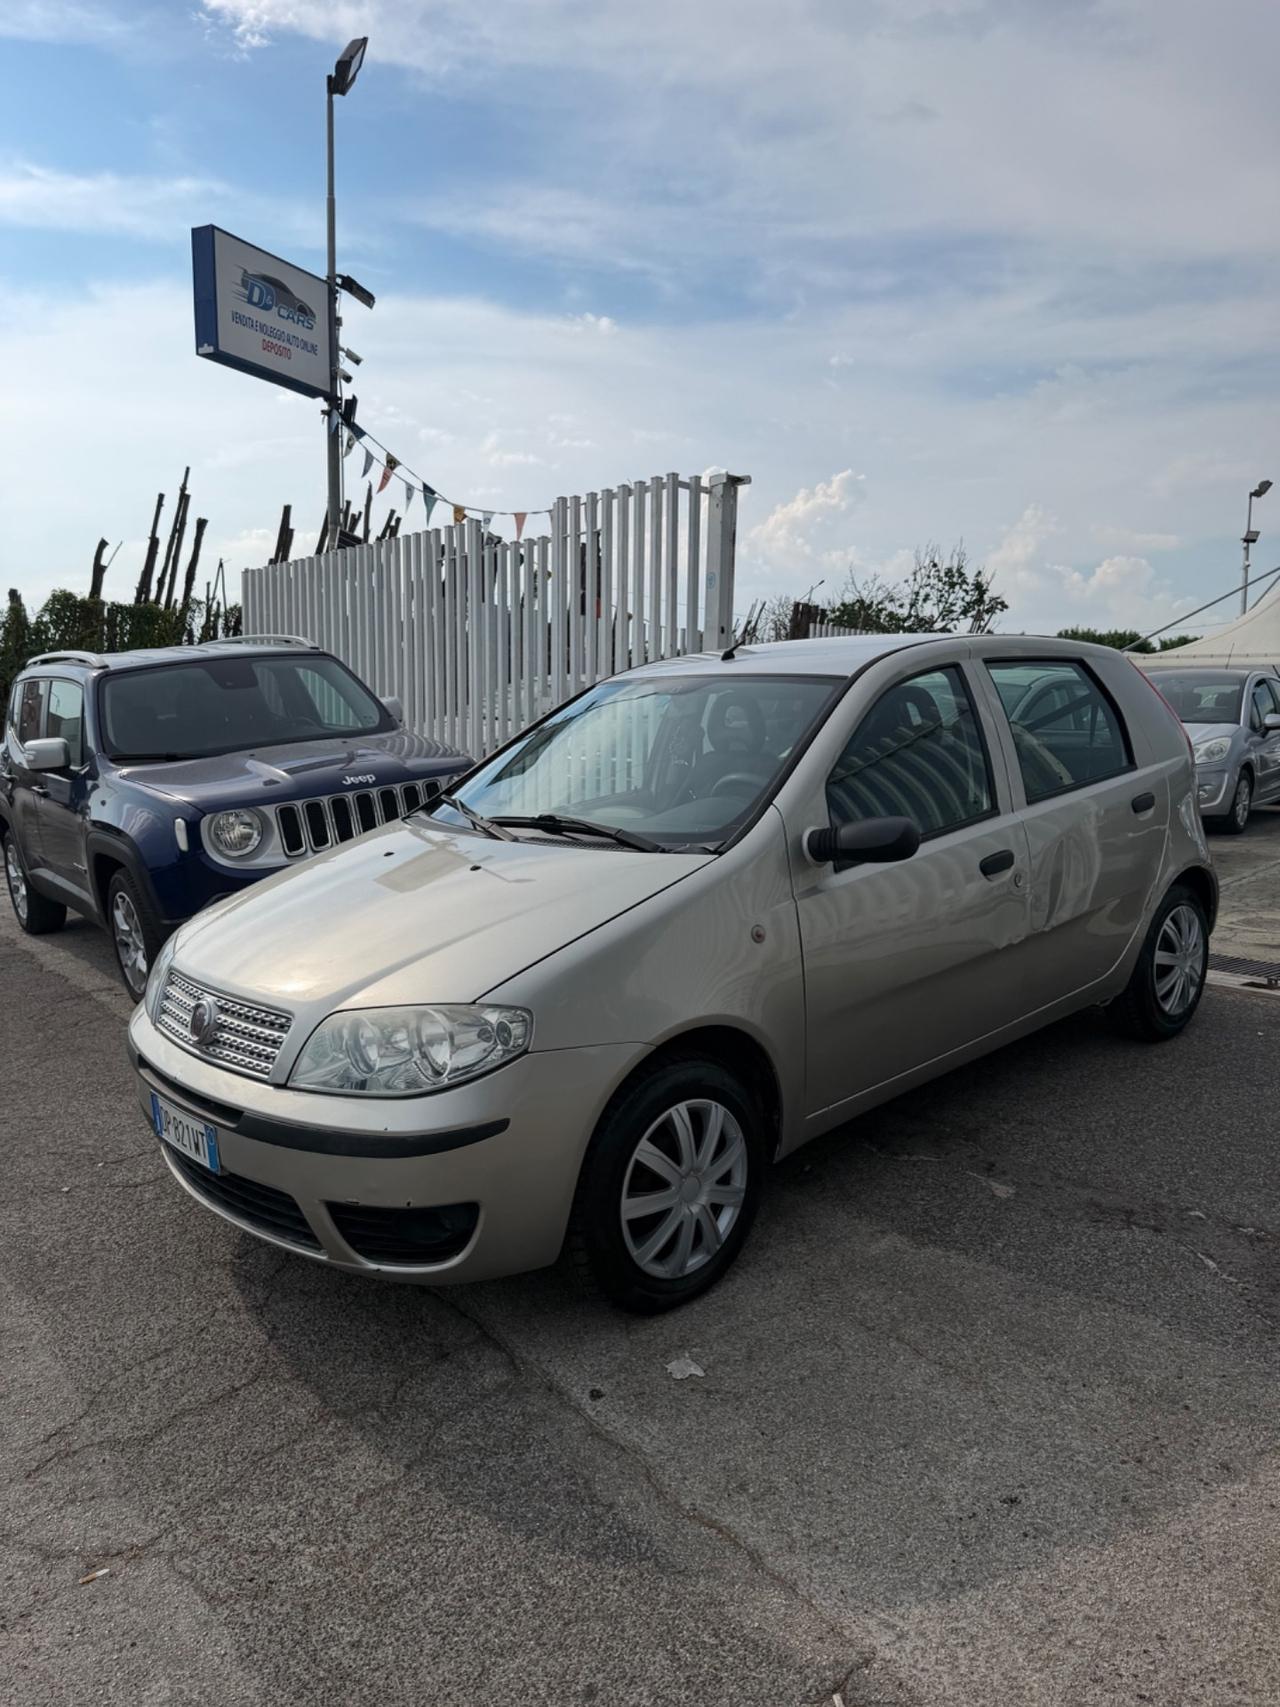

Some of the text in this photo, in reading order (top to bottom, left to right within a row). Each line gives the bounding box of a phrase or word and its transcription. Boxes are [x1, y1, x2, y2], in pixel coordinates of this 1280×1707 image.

[277, 304, 315, 331] CARS
[231, 310, 255, 329] VENDITA
[260, 322, 286, 342] NOLEGGIO
[286, 332, 300, 349] AUTO
[300, 338, 318, 356] ONLINE
[262, 339, 292, 360] DEPOSITO
[341, 774, 376, 785] Jeep
